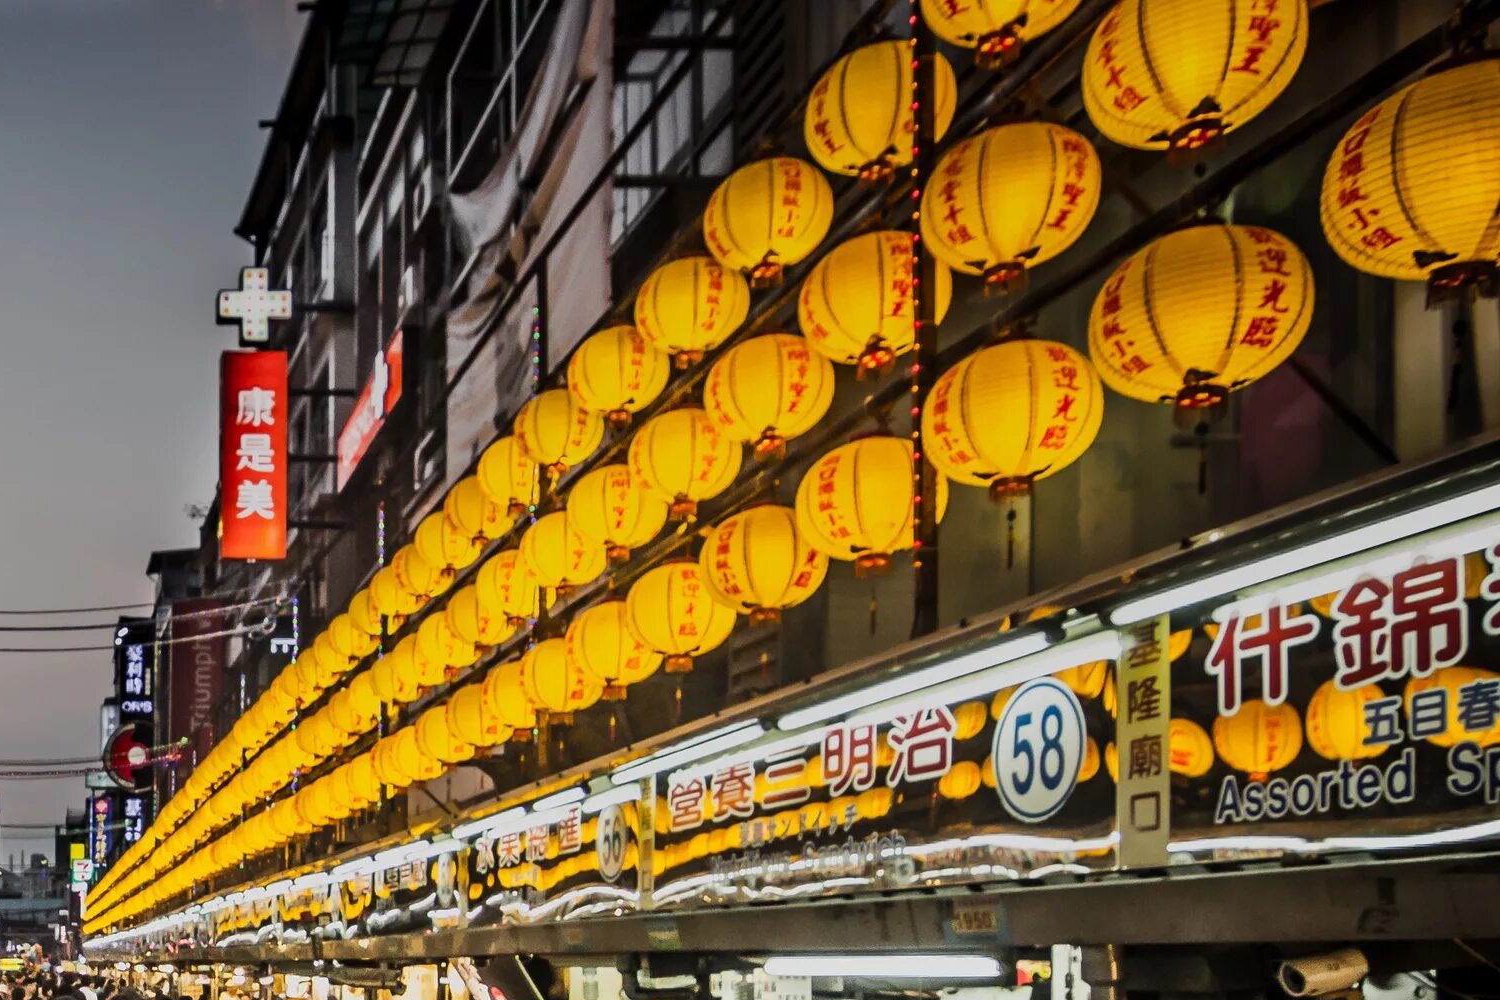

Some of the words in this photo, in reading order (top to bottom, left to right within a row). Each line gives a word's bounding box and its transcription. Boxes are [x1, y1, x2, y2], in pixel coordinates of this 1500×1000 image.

[235, 386, 276, 520] 康是美
[1206, 540, 1500, 718] 什錦
[670, 704, 955, 830] 營養三明治
[1010, 703, 1065, 798] 58
[1126, 620, 1163, 833] 基隆廟口
[1215, 749, 1414, 823] Assorted
[602, 814, 622, 866] 56
